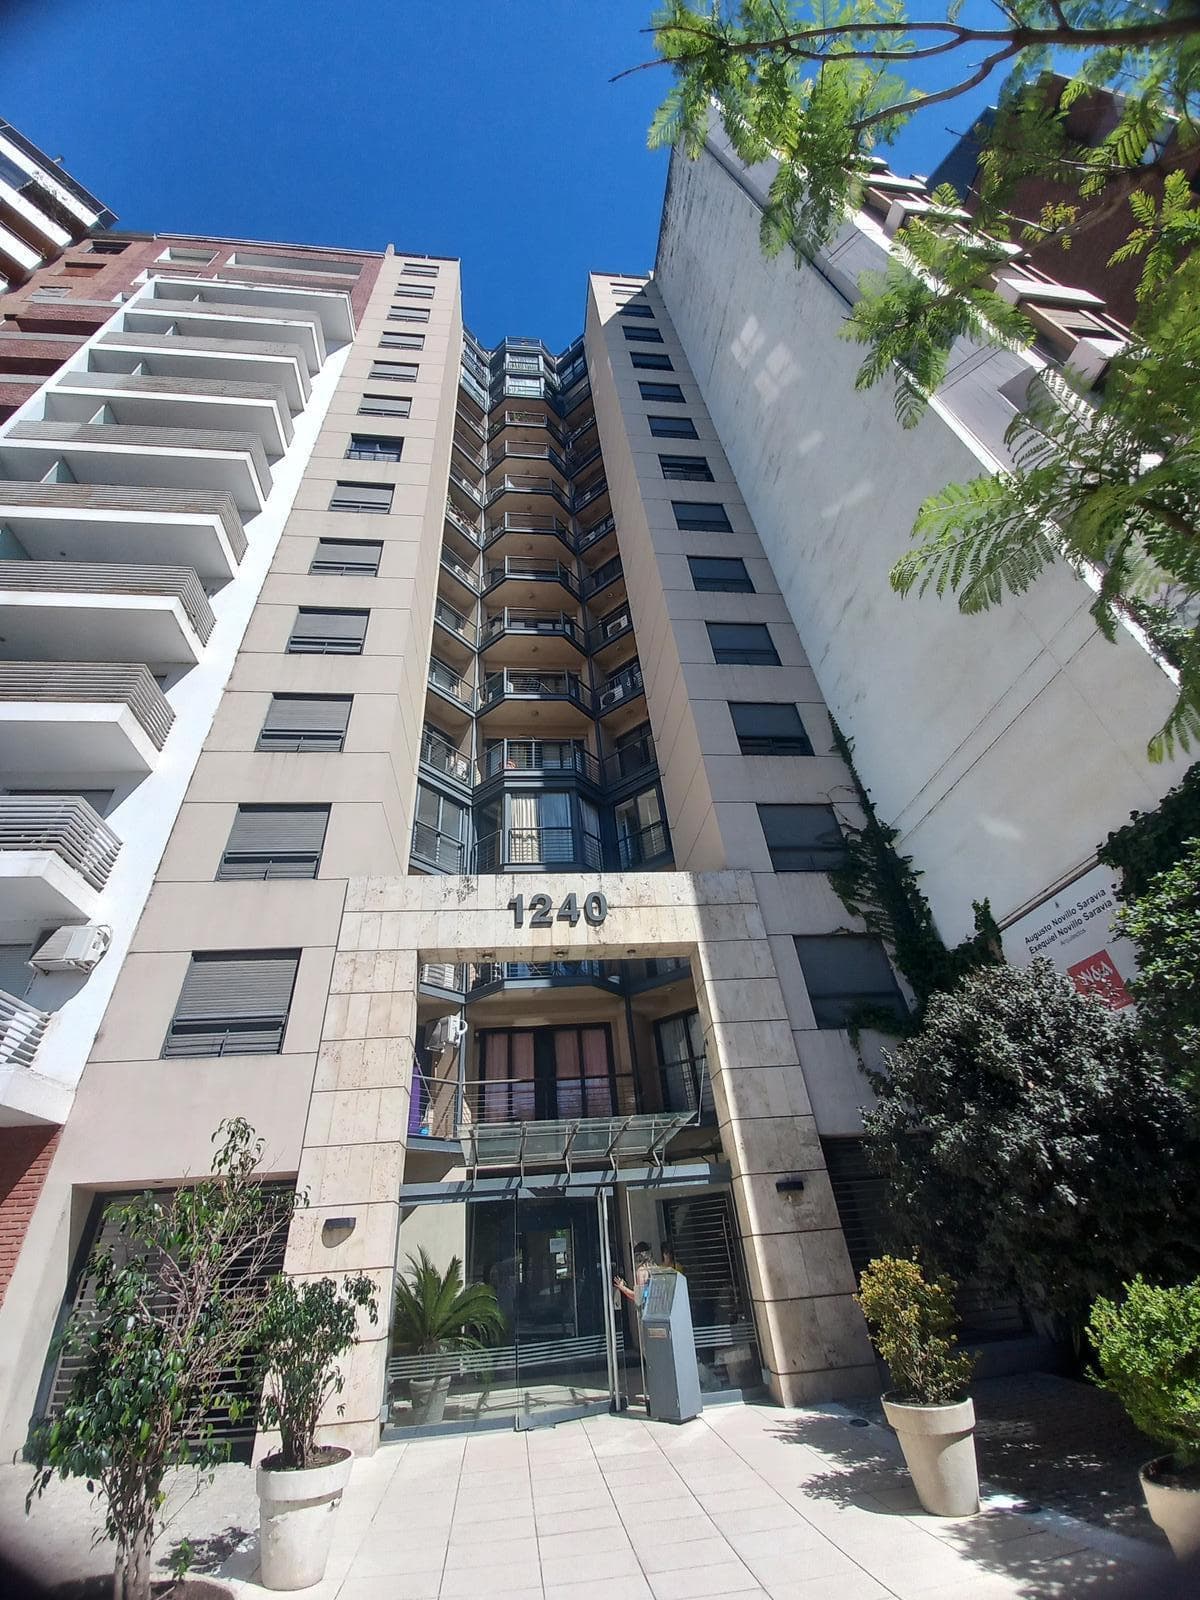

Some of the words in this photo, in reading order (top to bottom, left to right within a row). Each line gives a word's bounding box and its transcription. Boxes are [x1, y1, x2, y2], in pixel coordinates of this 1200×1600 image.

[507, 892, 607, 929] 1240
[1024, 924, 1052, 944] Augusto
[1051, 907, 1077, 926] Novillo
[1076, 888, 1106, 910] Saravia
[1028, 933, 1058, 954] Exequiel
[1057, 918, 1083, 936] Novillo
[1082, 899, 1113, 921] Saravia
